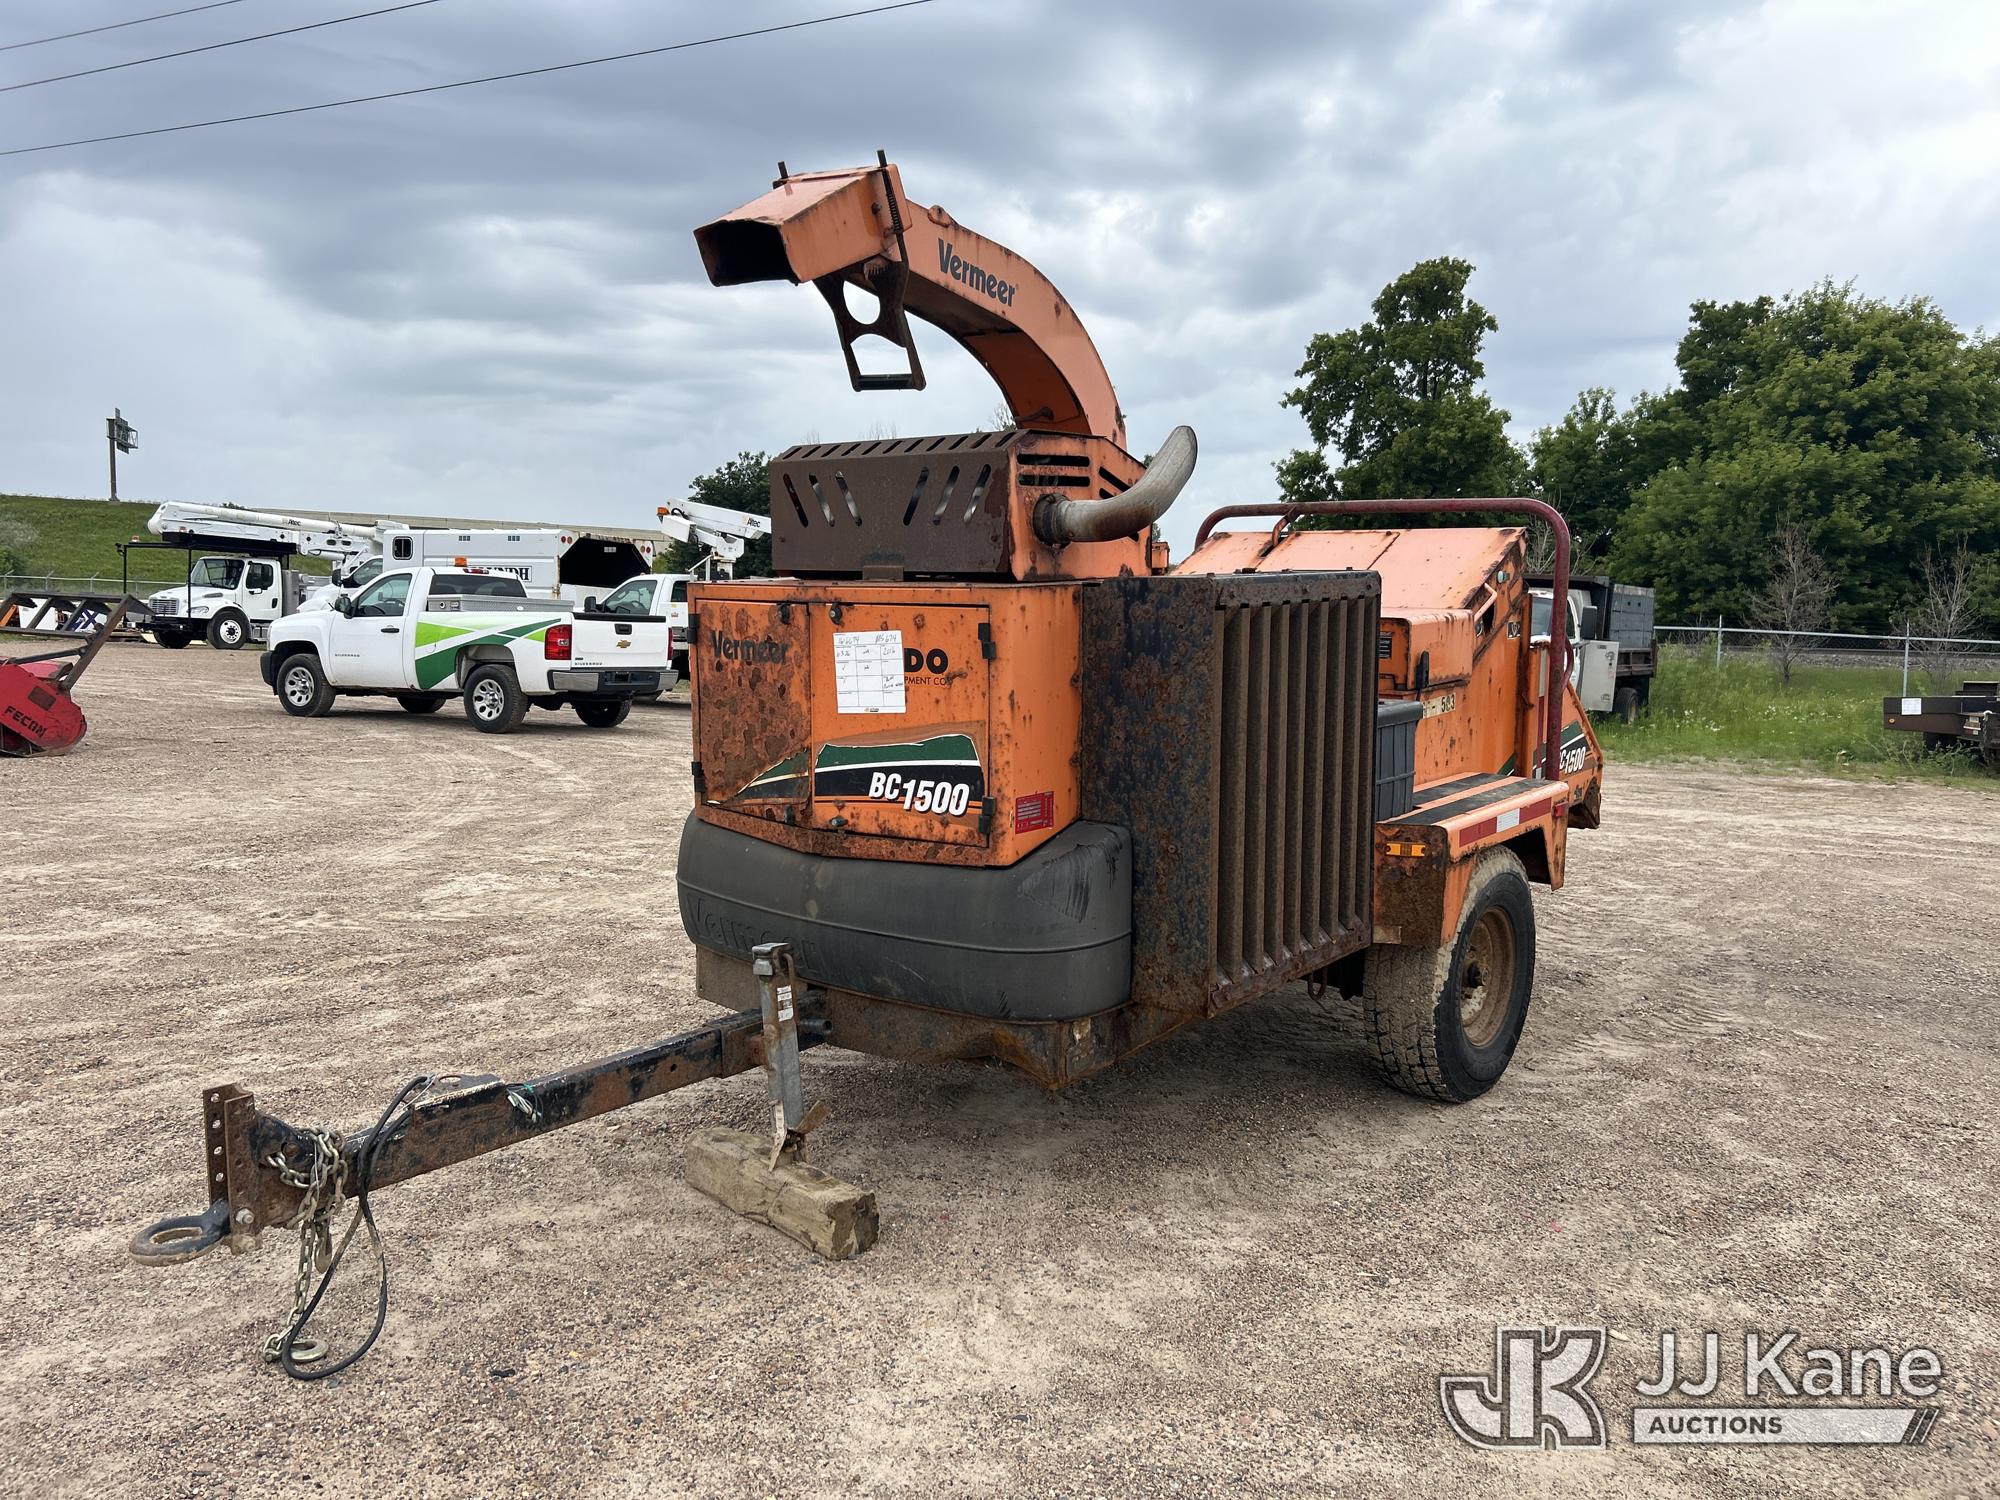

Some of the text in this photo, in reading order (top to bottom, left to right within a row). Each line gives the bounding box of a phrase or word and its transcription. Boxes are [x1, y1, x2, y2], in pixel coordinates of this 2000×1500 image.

[938, 237, 1015, 307] Vermeer
[711, 629, 788, 665] Vermeer
[904, 648, 949, 674] DO
[904, 676, 931, 685] PMENT
[4, 705, 48, 738] FECON
[1560, 746, 1586, 774] C1500
[869, 771, 970, 816] BC1500
